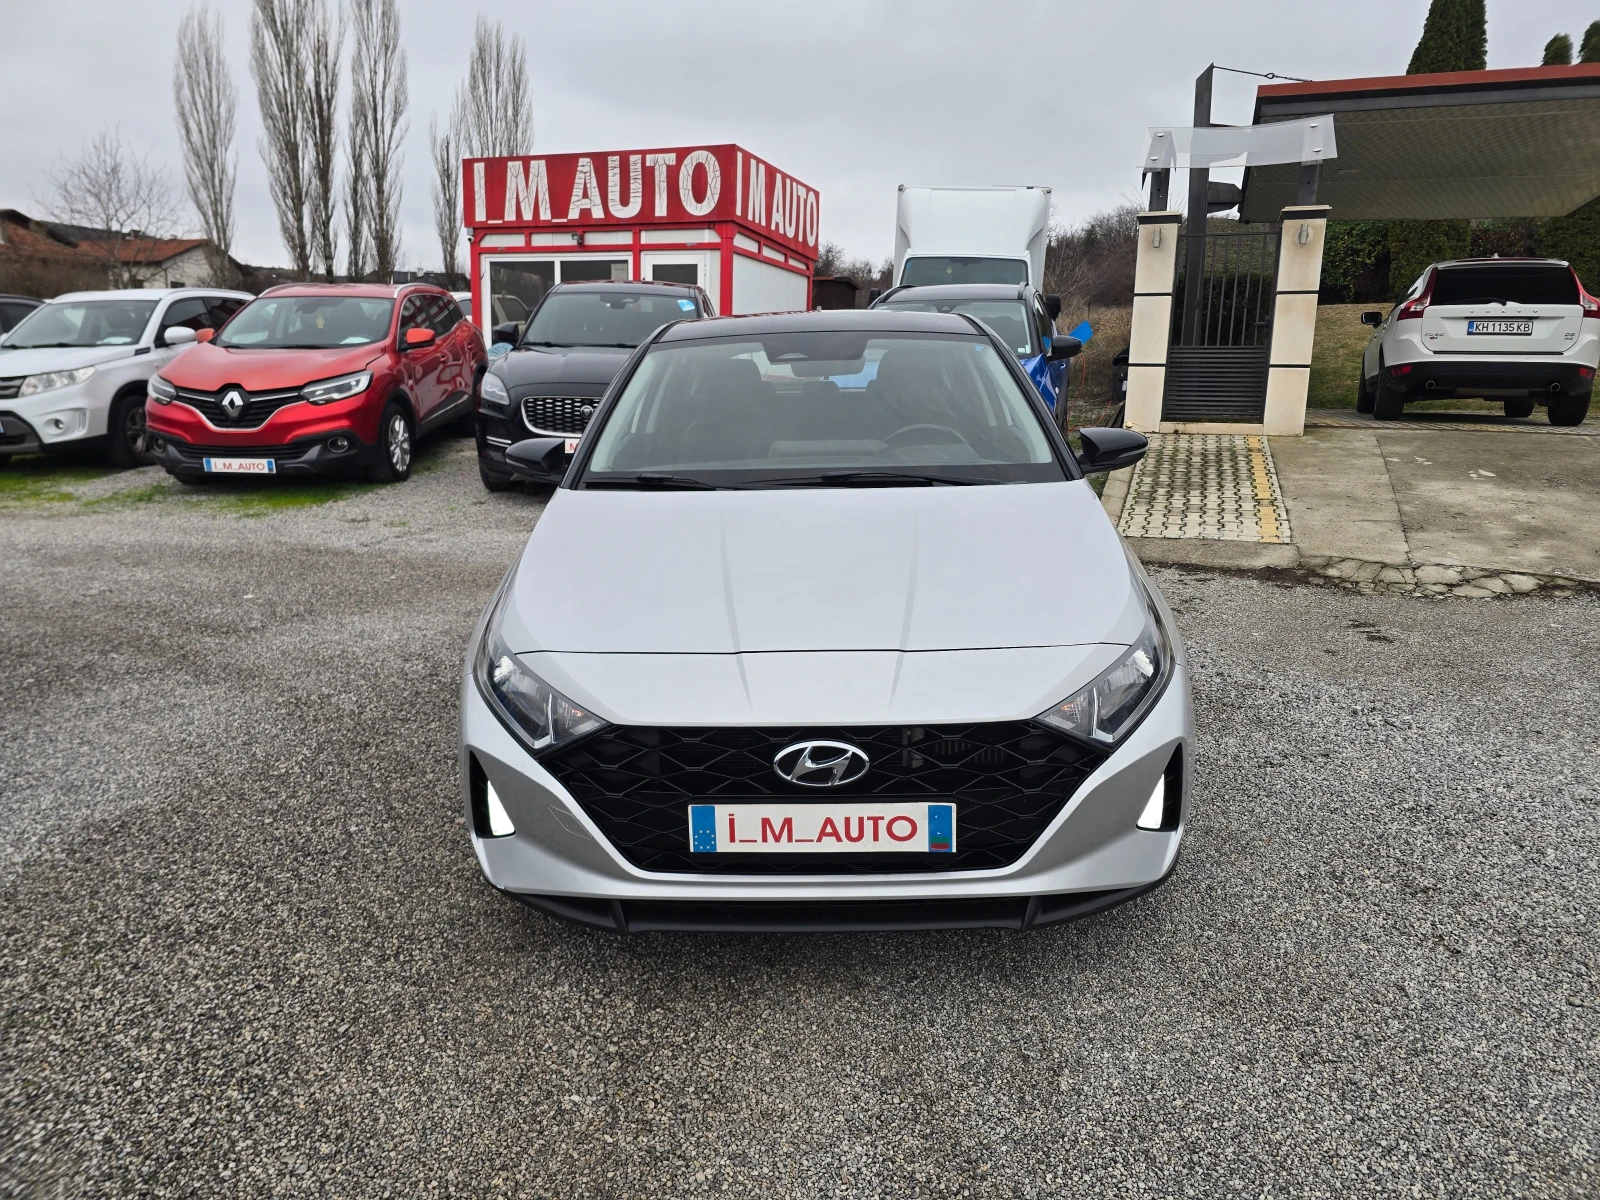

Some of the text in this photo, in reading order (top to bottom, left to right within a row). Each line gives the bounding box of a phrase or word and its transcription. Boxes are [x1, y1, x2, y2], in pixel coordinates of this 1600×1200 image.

[736, 151, 817, 247] I M AUTO
[1475, 322, 1531, 332] KH 1135 KB
